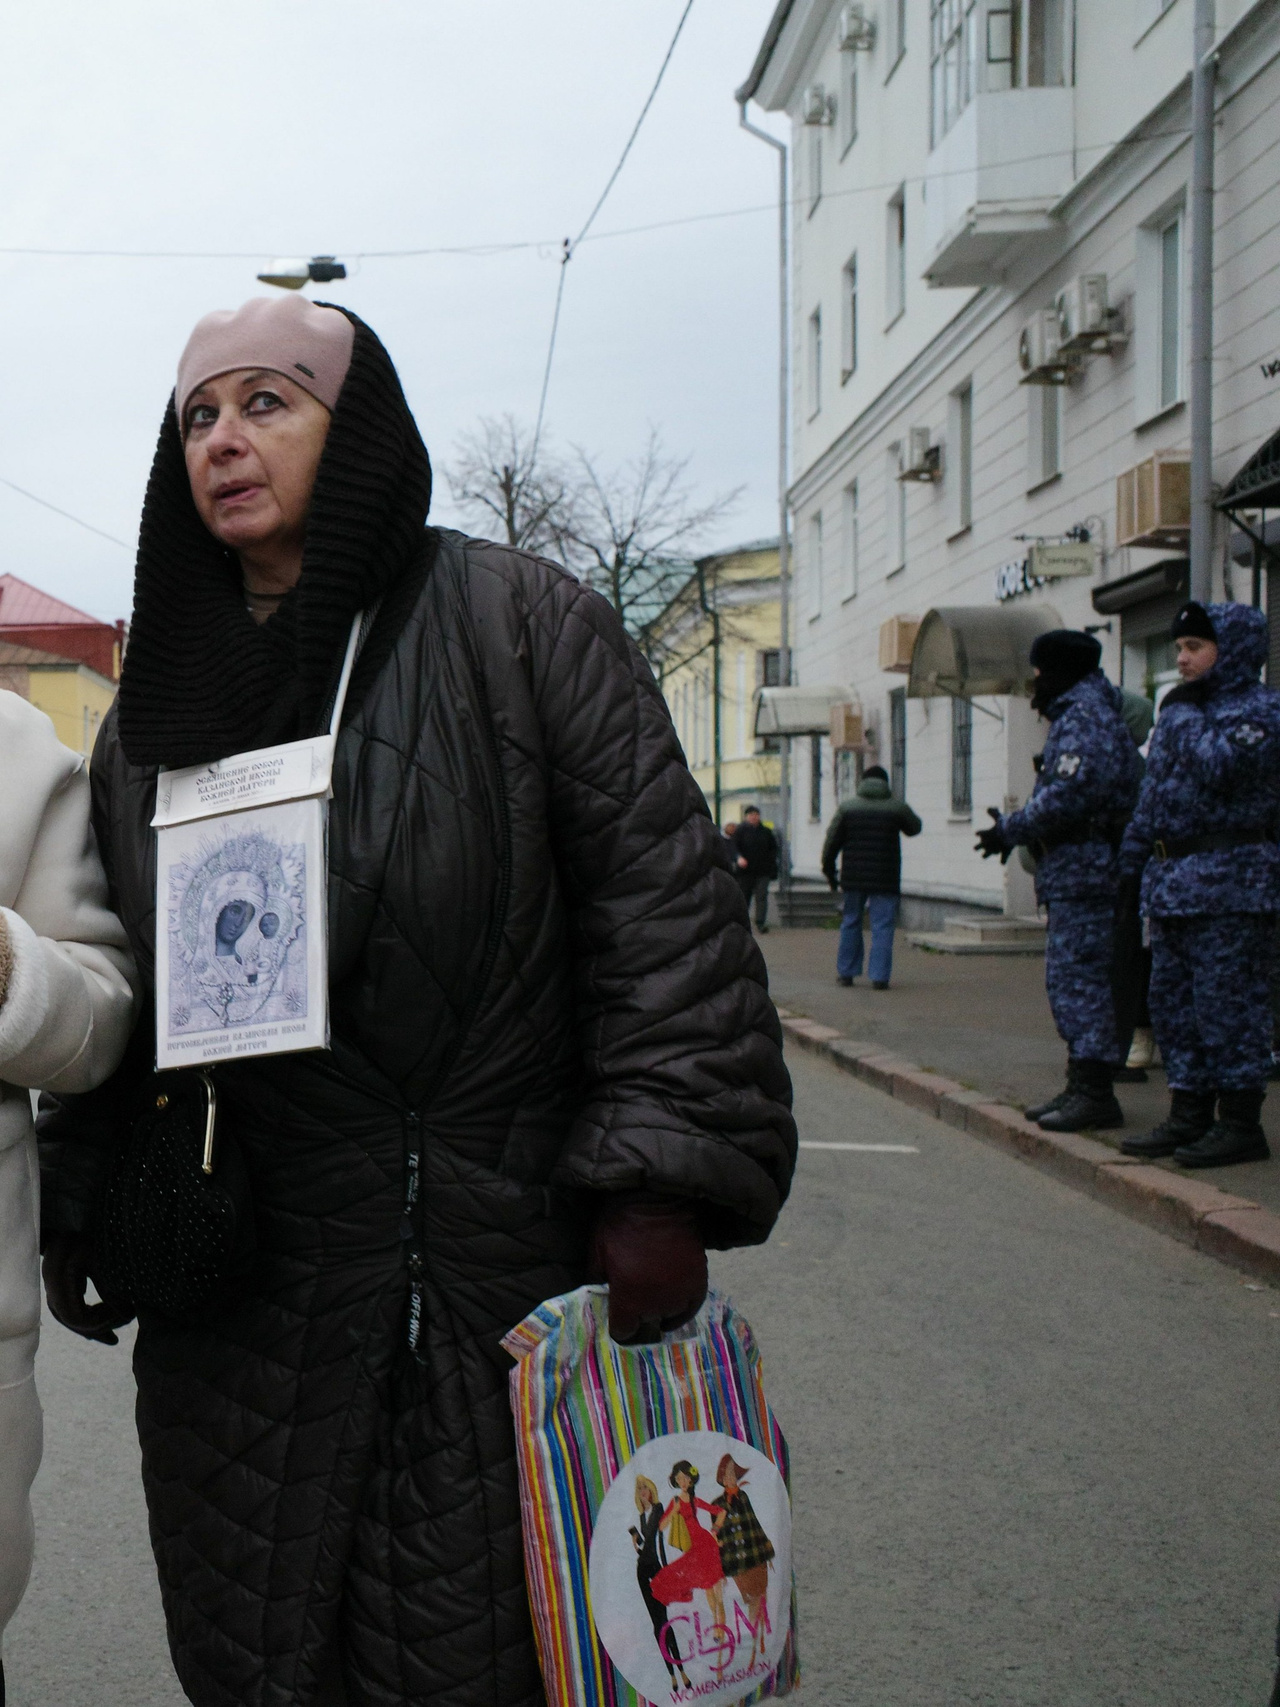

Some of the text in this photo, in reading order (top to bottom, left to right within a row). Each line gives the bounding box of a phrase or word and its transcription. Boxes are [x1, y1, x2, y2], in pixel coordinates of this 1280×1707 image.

[195, 758, 285, 786] ОСВЯЩЕНИЕ СОБОРА
[197, 768, 281, 795] КАЗАНСКОЙ ИКОНЫ
[237, 778, 276, 794] МАТЕРИ
[669, 1660, 773, 1705] WOMEN FASHION
